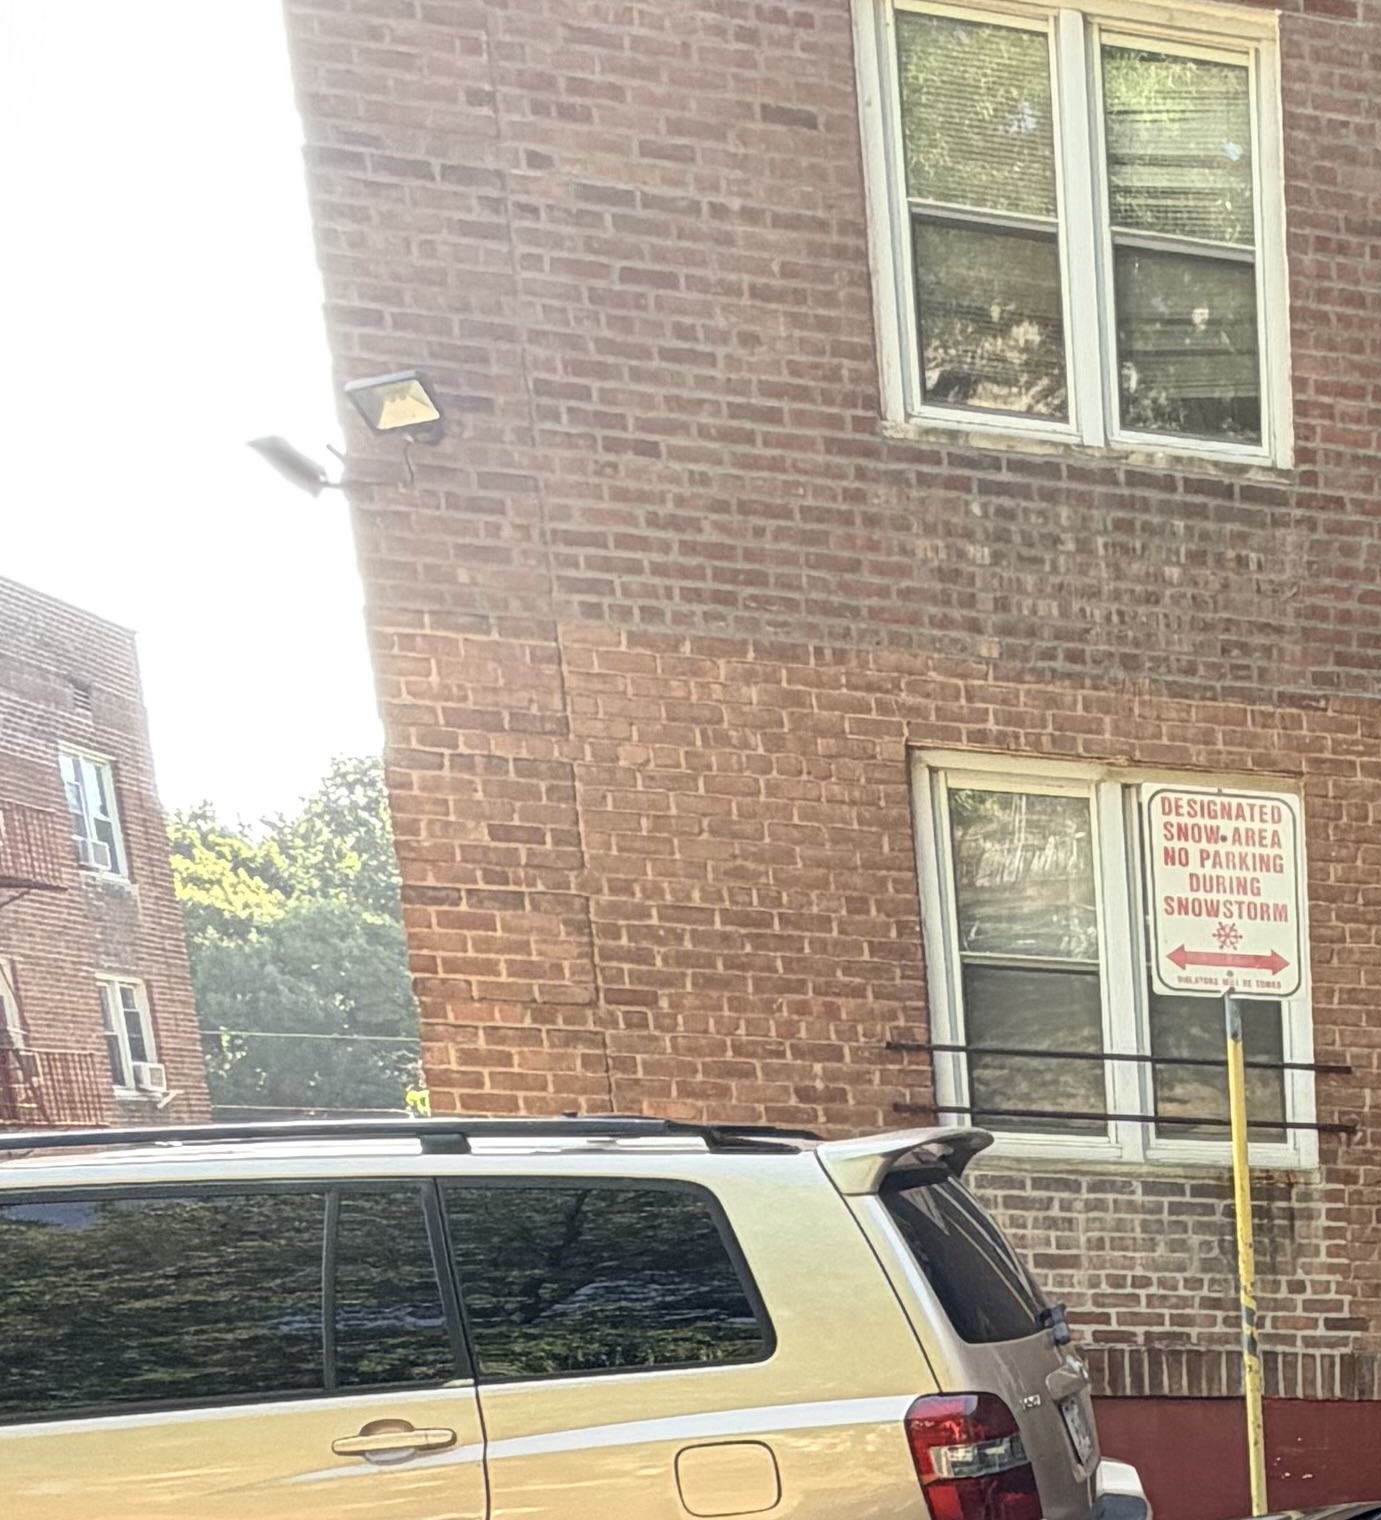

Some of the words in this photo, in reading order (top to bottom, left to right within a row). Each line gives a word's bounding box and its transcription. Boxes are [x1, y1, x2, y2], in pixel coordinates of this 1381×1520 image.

[1160, 796, 1282, 825] DESIGNATED
[1163, 821, 1221, 844] SNOW
[1231, 826, 1282, 849] AREA
[1163, 846, 1190, 867] NO
[1199, 848, 1284, 874] PARKING
[1189, 872, 1261, 897] DURING
[1163, 896, 1289, 923] SNOWSTORM
